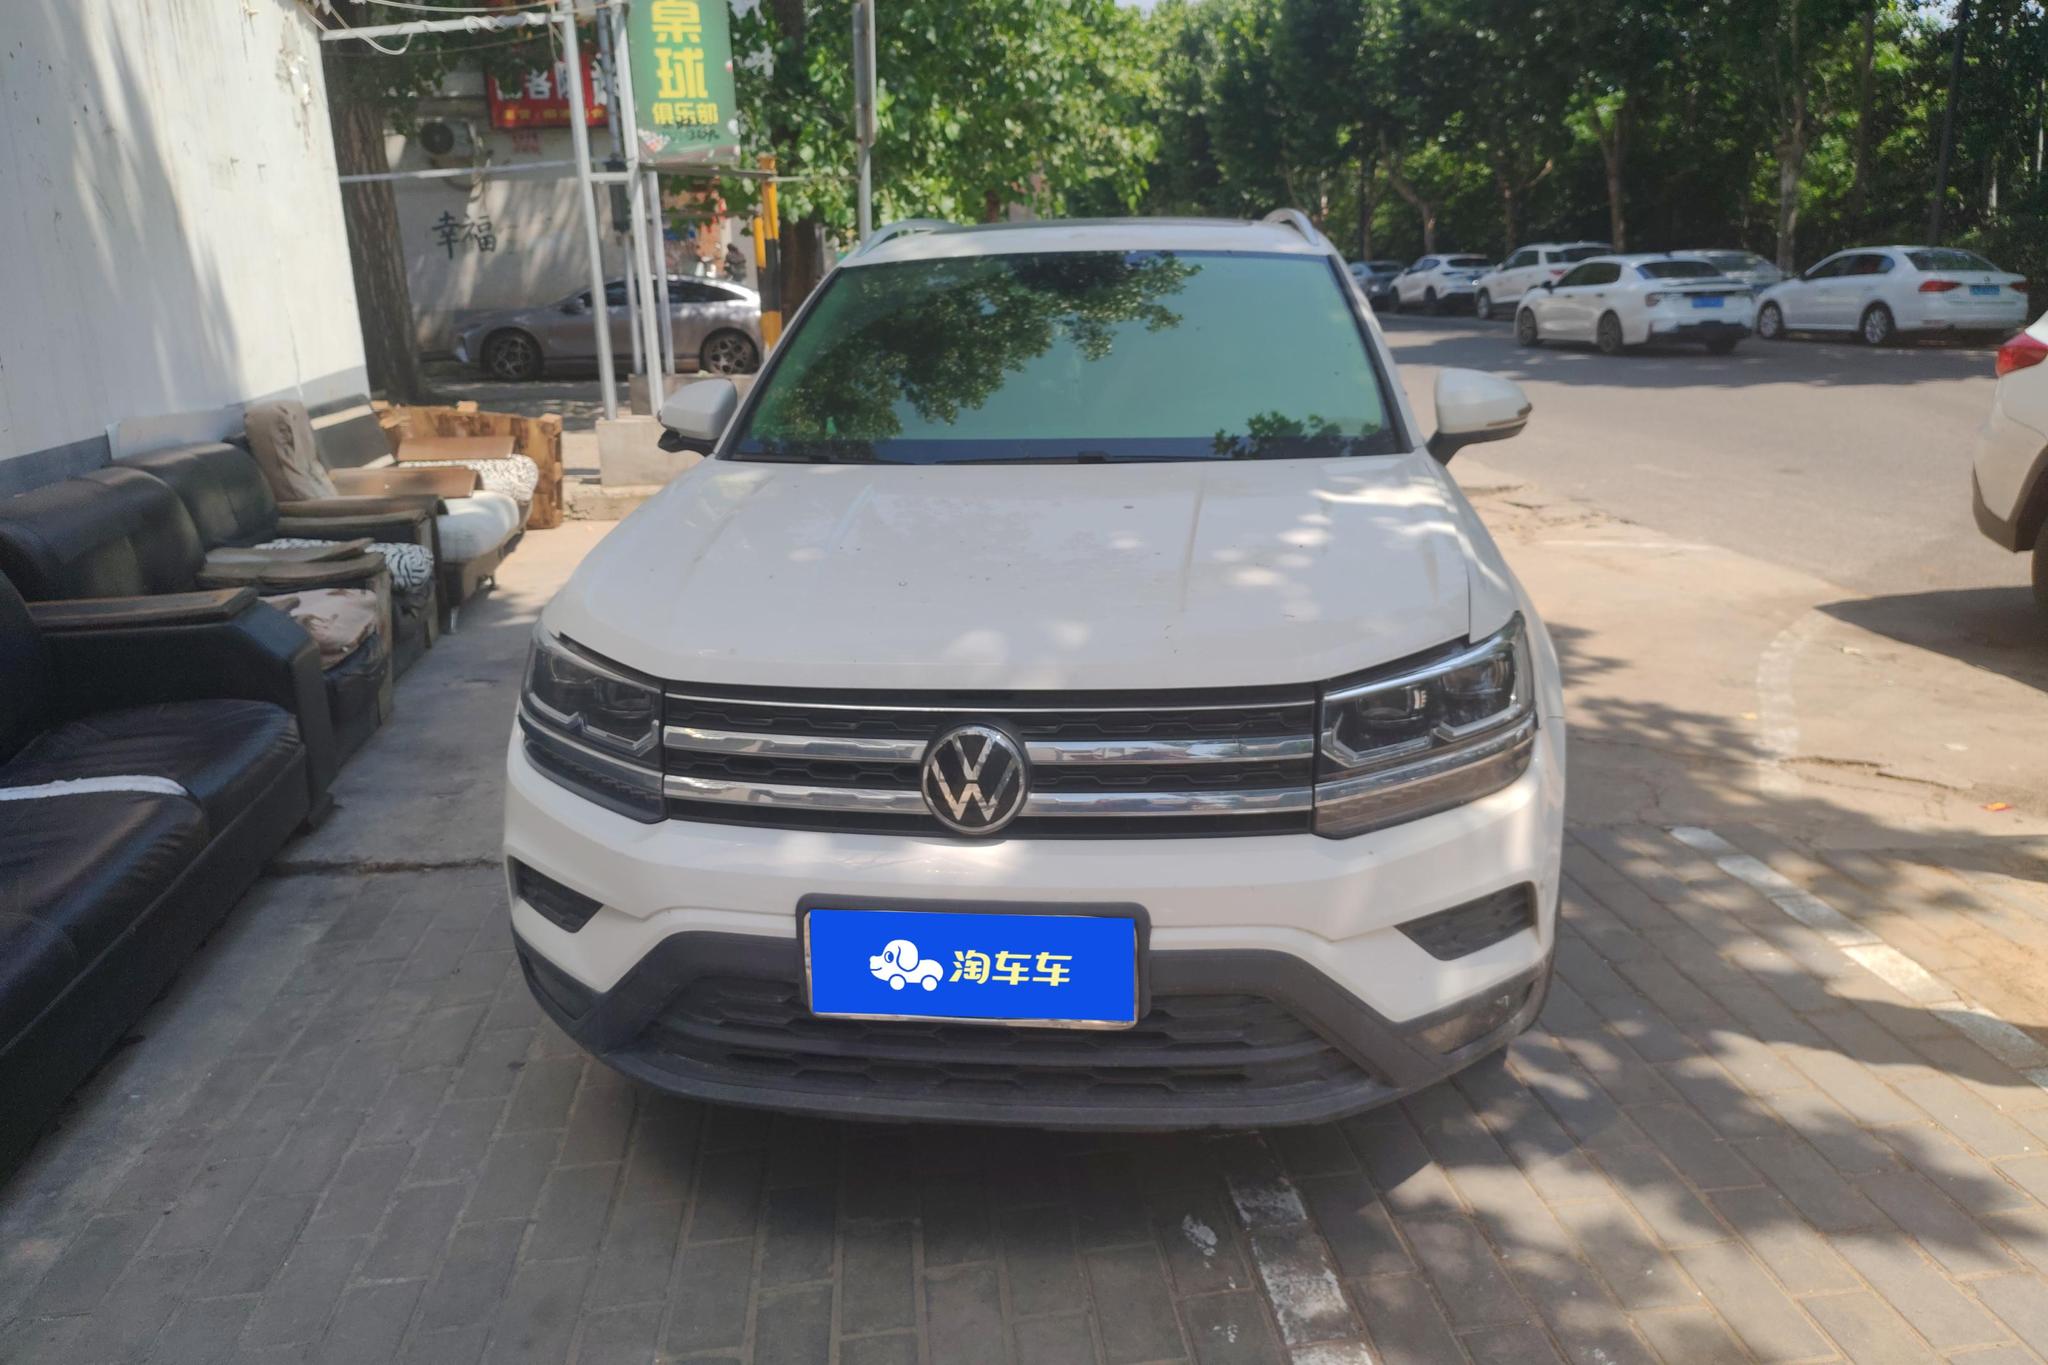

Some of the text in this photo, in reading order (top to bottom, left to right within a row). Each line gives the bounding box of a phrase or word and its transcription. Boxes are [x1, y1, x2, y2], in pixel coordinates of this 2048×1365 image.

[652, 101, 719, 125] 俱乐部
[432, 210, 496, 259] 幸福
